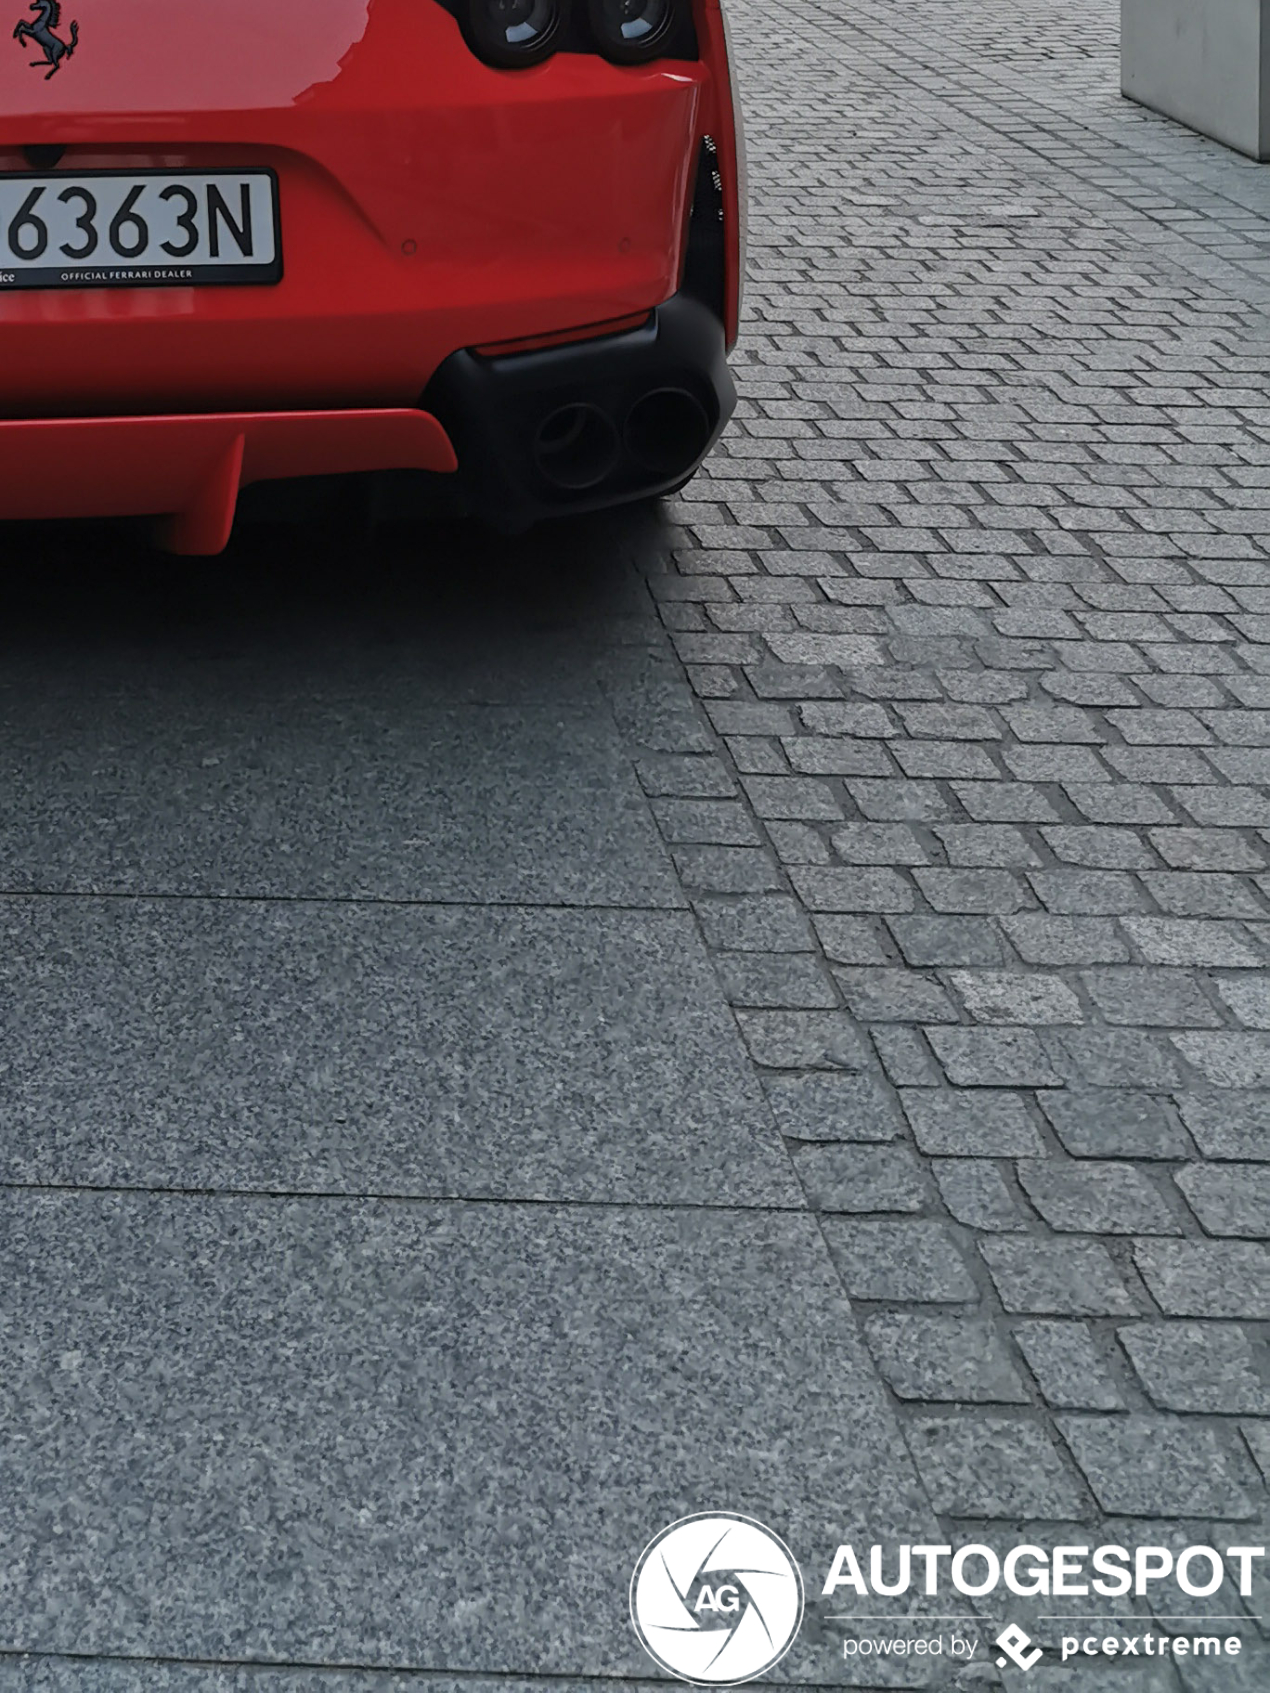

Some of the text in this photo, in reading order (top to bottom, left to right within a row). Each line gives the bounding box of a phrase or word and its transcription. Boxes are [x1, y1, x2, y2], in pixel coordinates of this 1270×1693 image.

[7, 183, 254, 261] 6363N
[60, 269, 193, 281] OFFICIAL FERRARI DEALER
